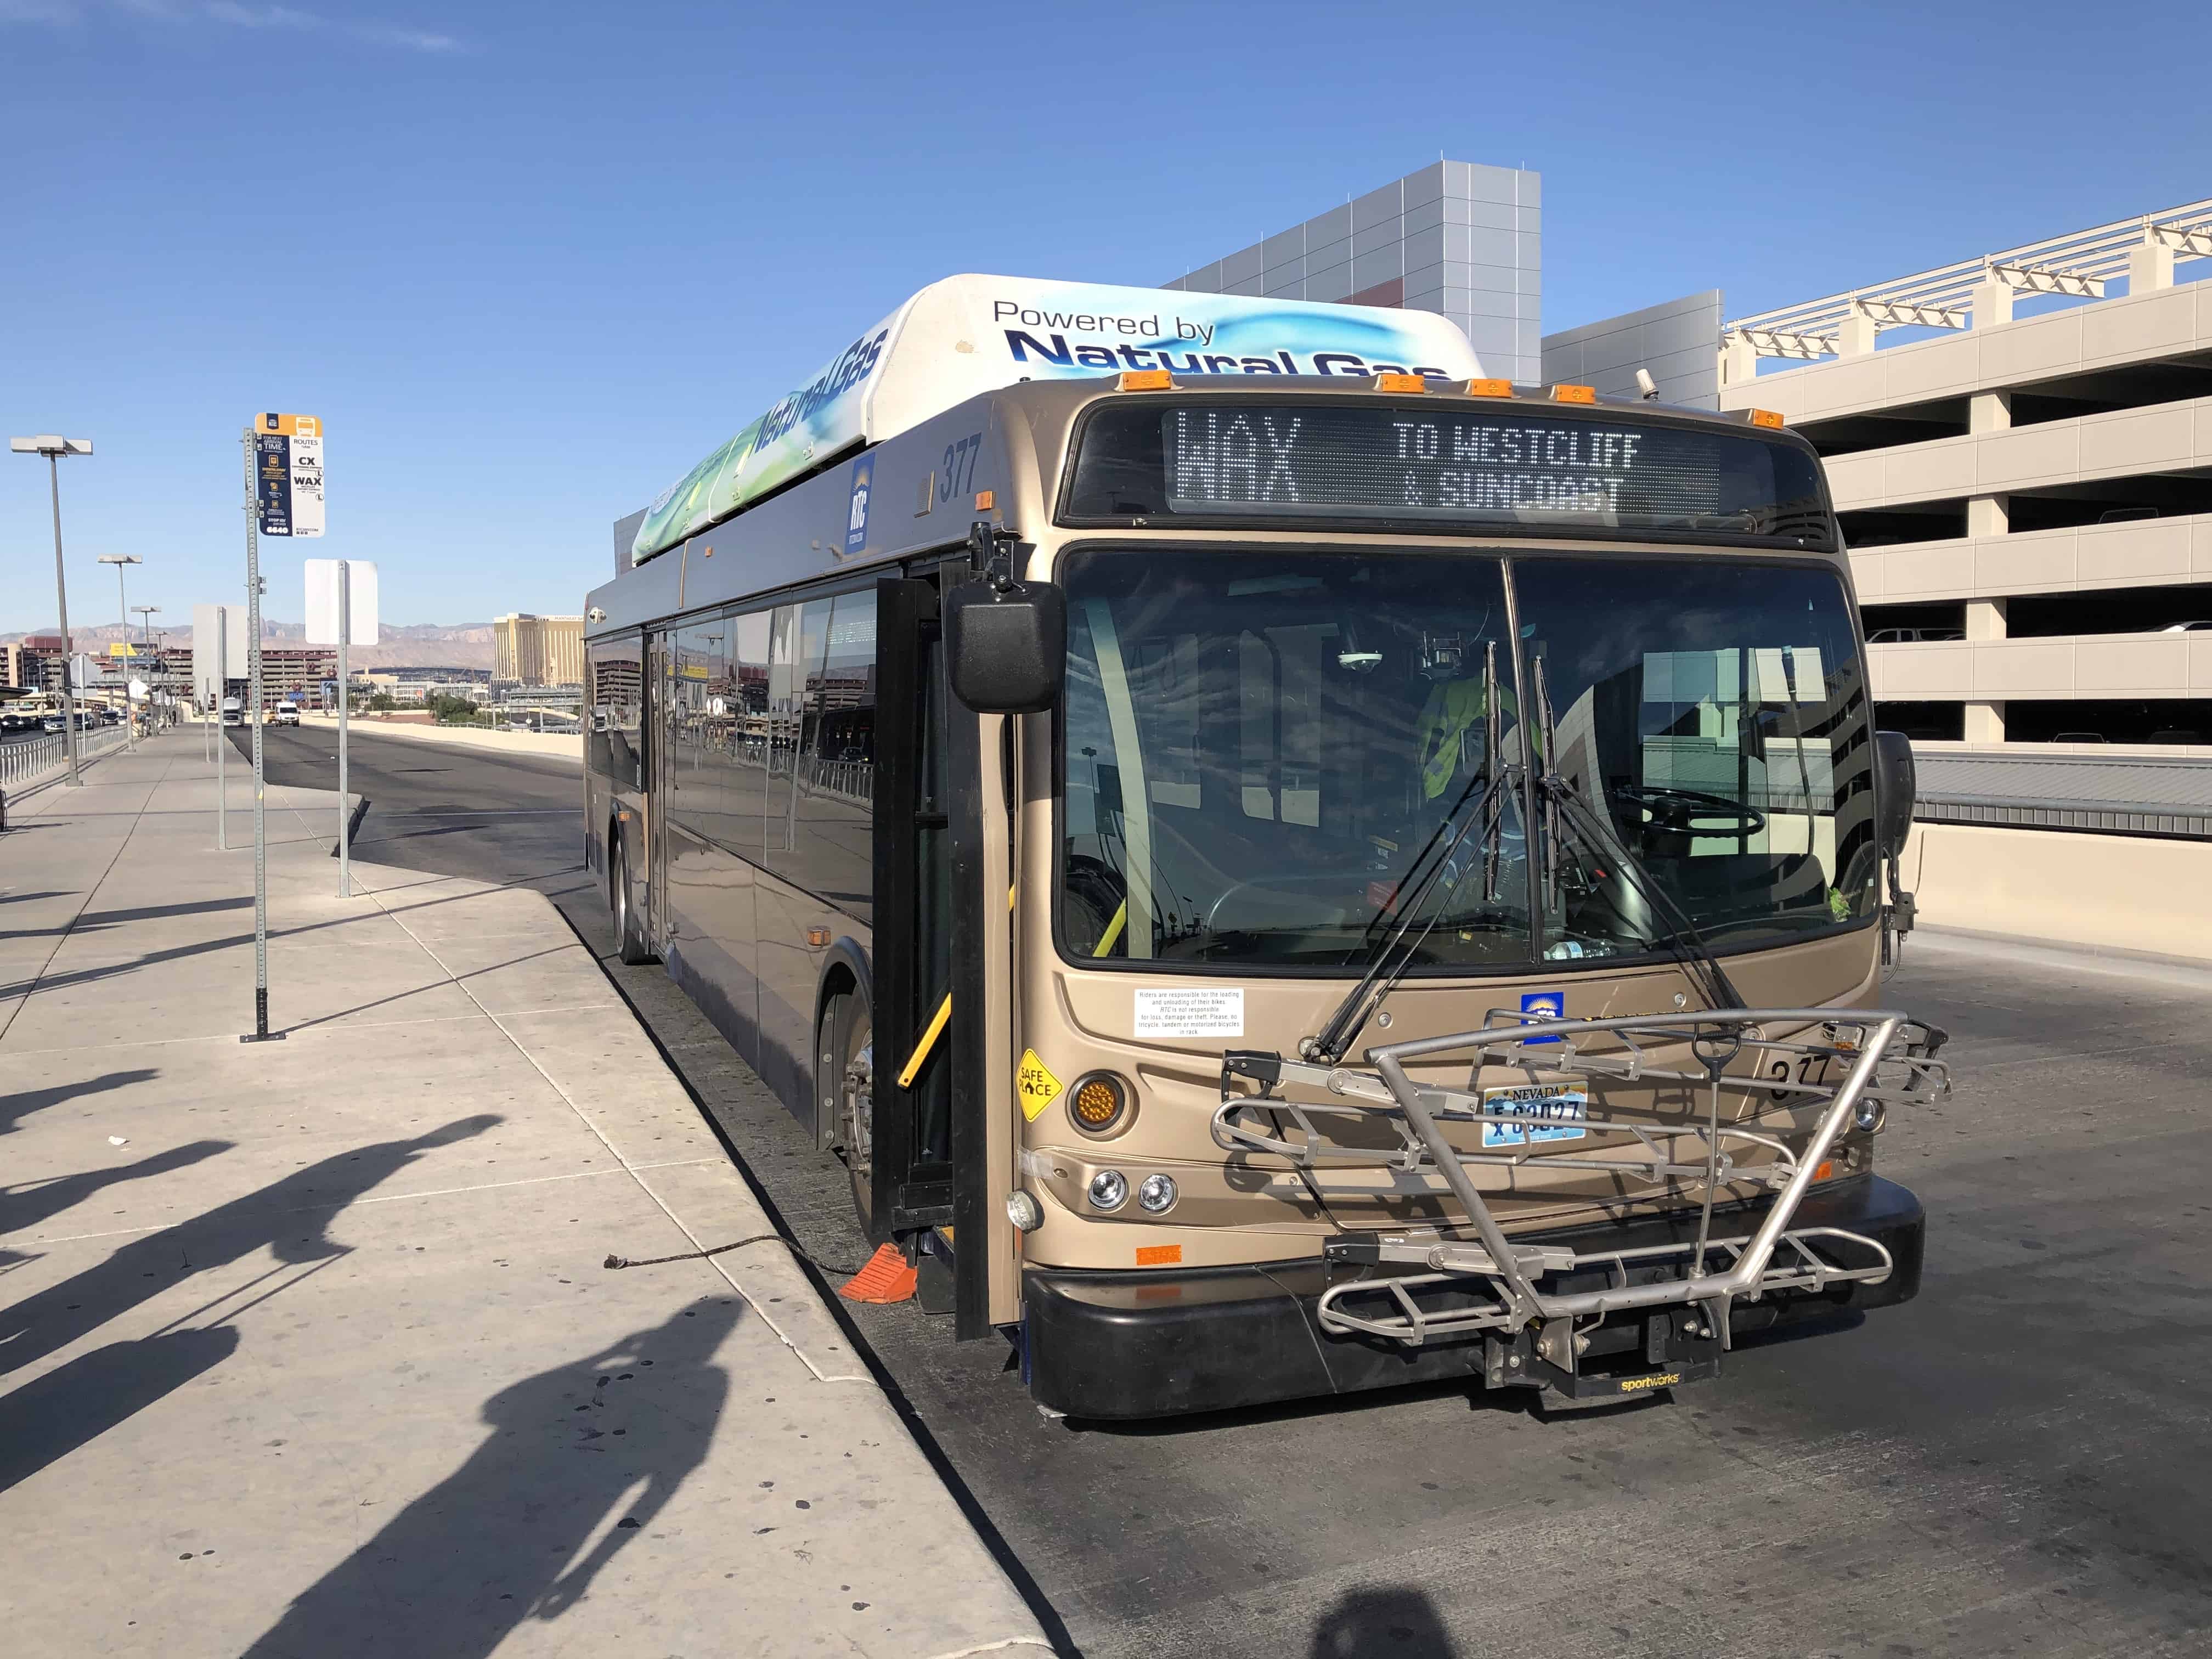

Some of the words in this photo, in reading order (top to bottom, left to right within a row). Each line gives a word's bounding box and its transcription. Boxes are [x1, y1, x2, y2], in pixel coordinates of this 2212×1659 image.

[994, 301, 1160, 337] Powered
[1176, 317, 1214, 346] by
[1003, 329, 1299, 374] Natural
[747, 353, 843, 459] Natural
[825, 328, 889, 405] Gas
[298, 457, 315, 466] CX
[1177, 412, 1301, 501] WAX
[1393, 423, 1438, 459] TO
[1454, 425, 1641, 468] WESTCLIFF
[294, 476, 321, 486] WAX
[940, 432, 982, 503] 377
[850, 490, 867, 531] RTC
[1440, 472, 1624, 512] SUNCOAST
[1021, 1067, 1043, 1082] SAFE
[1513, 1086, 1560, 1101] NEVADA
[1621, 1374, 1679, 1392] sportworks
